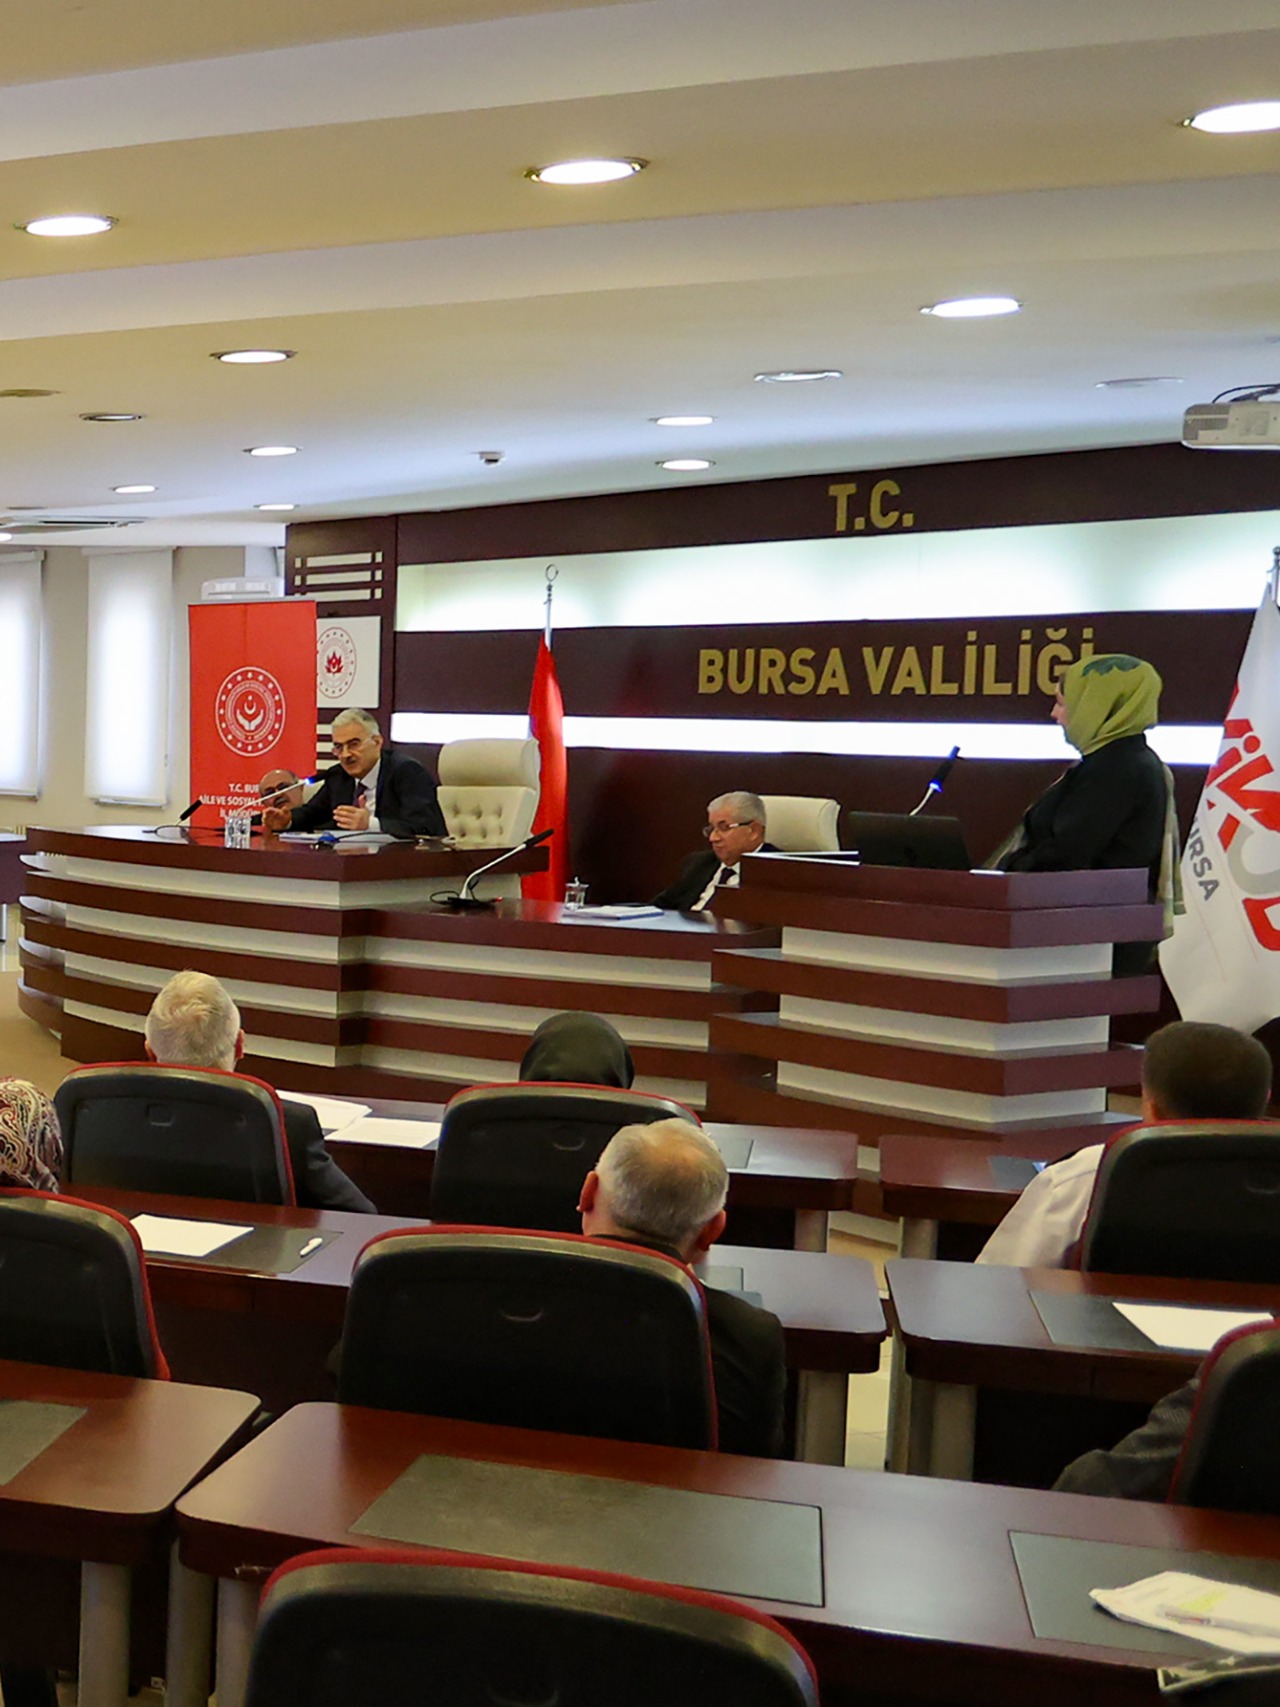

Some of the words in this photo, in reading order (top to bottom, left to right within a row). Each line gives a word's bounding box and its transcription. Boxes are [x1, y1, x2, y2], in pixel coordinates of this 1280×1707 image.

[828, 479, 914, 531] T.C.
[697, 647, 850, 695] BURSA
[228, 783, 243, 792] T.C.
